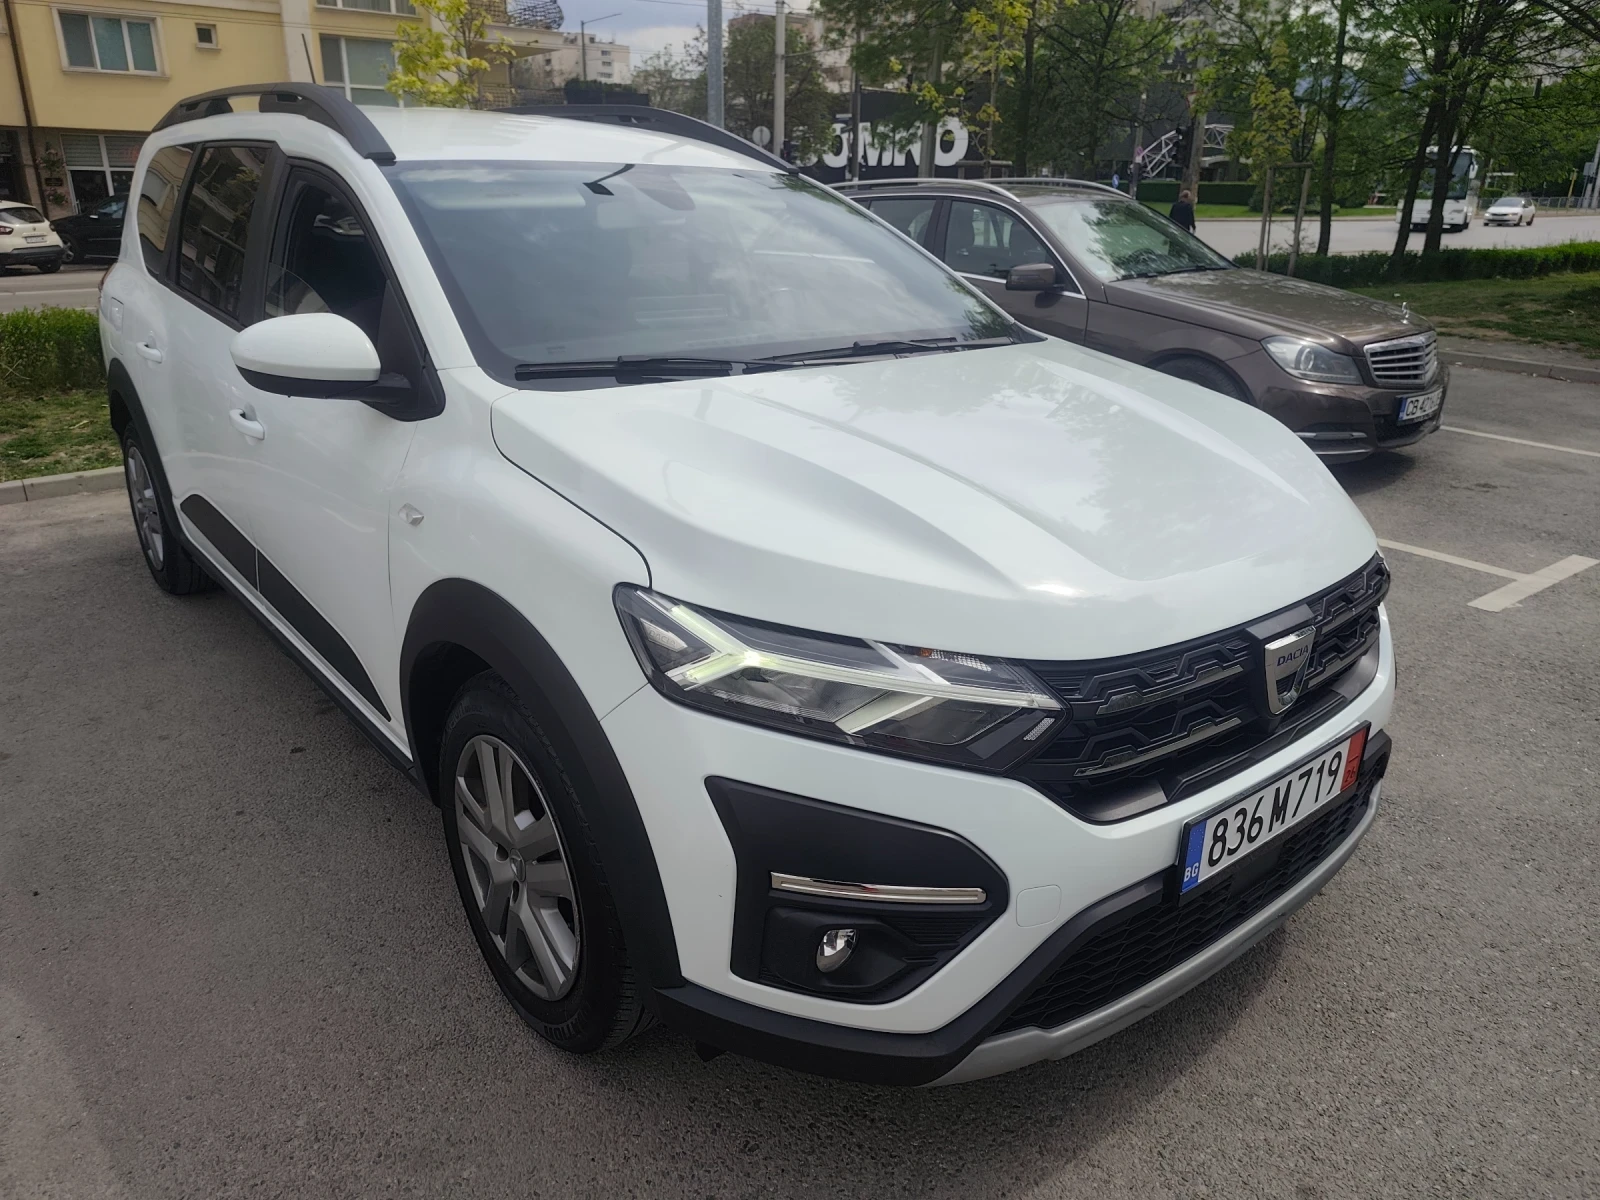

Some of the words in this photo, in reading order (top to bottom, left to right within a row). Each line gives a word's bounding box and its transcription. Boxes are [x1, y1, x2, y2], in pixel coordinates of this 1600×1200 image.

[648, 629, 676, 646] DACIA
[1277, 645, 1309, 667] DACIA
[1184, 862, 1199, 882] BG
